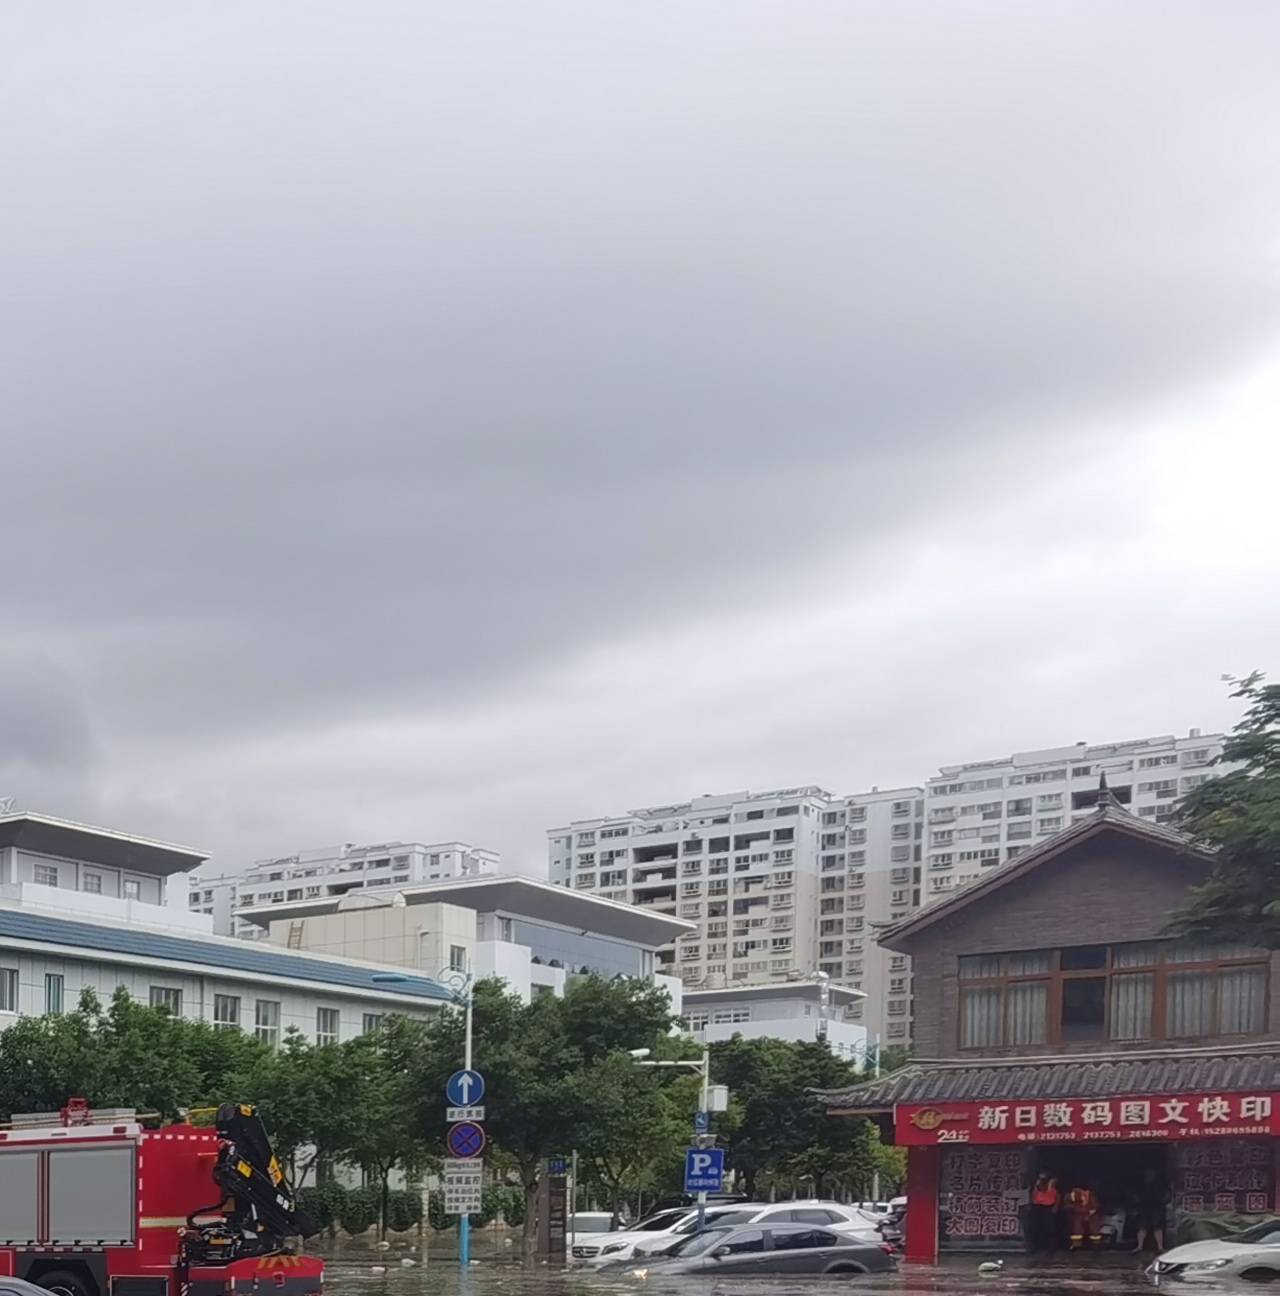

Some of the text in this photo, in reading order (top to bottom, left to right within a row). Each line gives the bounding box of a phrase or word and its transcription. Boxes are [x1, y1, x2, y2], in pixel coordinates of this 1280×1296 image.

[978, 1096, 1272, 1130] 新日数码图文快印
[691, 1154, 712, 1175] P
